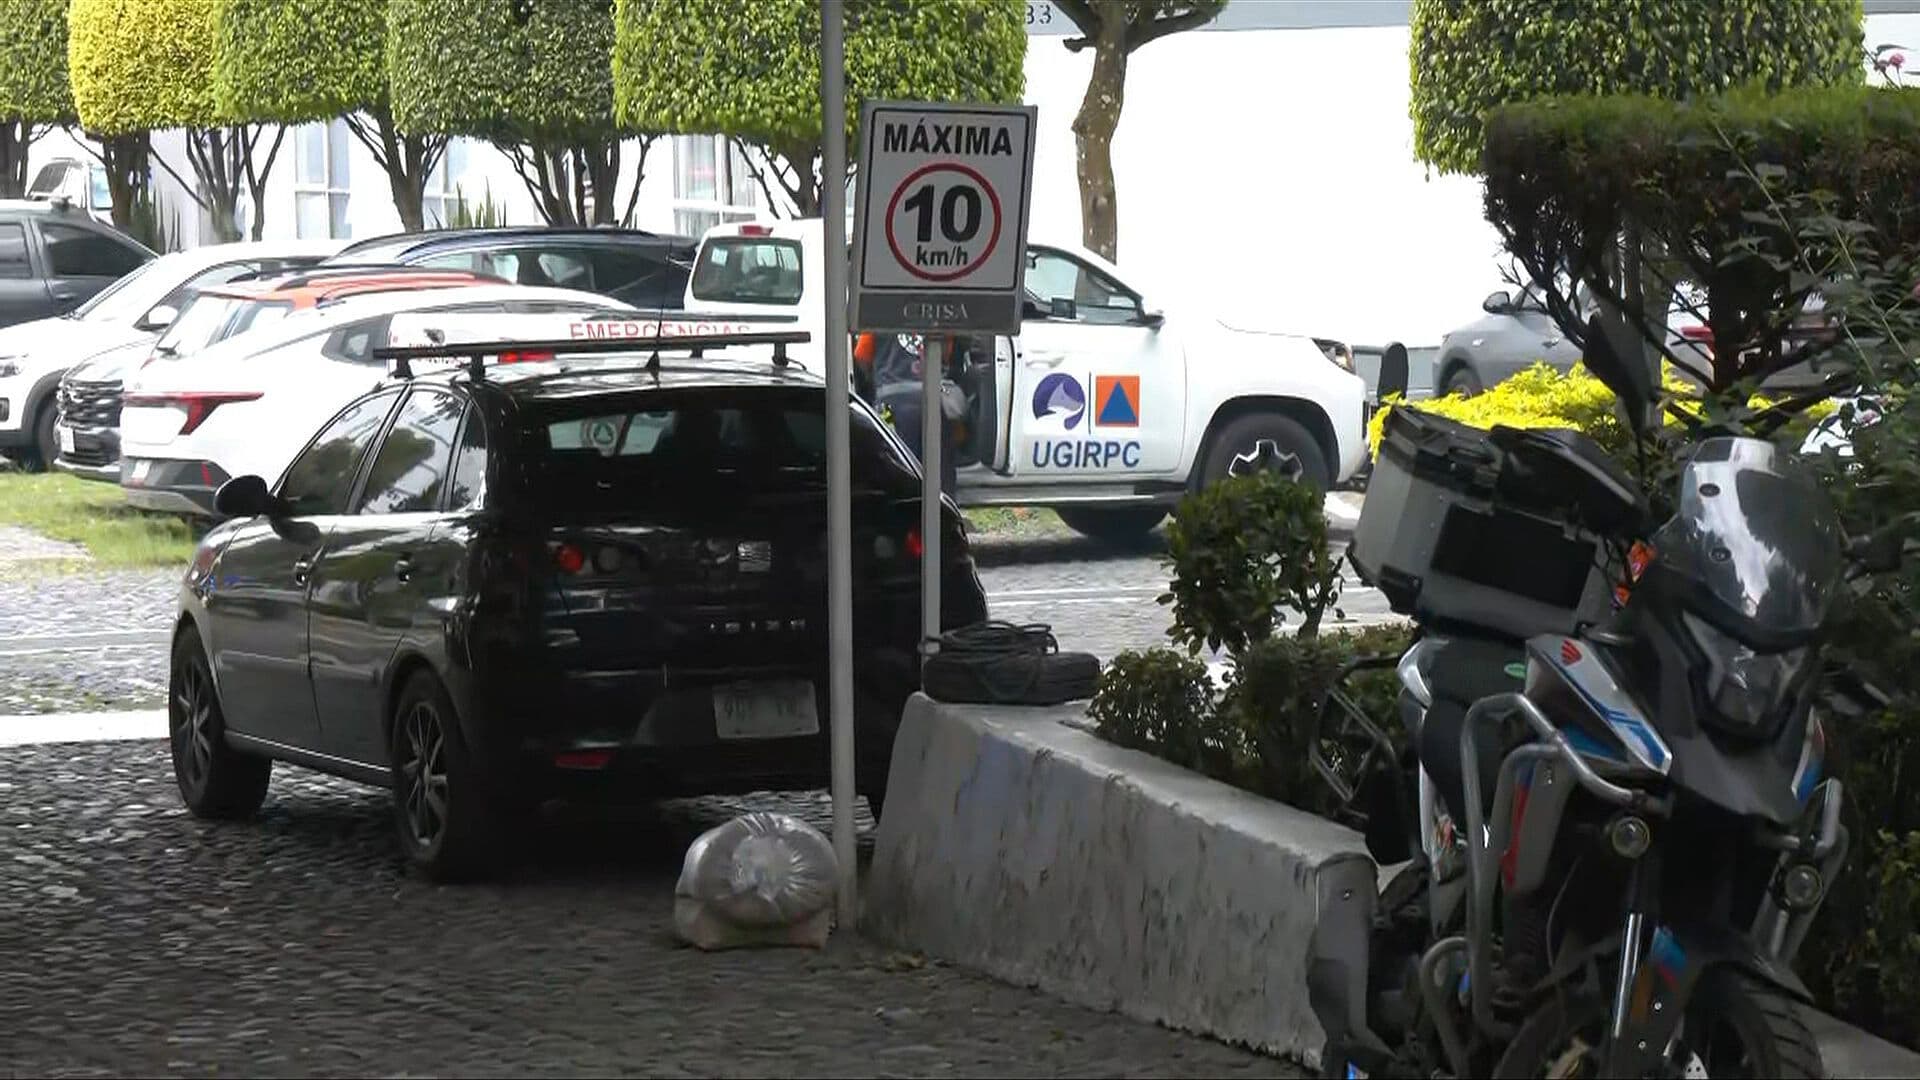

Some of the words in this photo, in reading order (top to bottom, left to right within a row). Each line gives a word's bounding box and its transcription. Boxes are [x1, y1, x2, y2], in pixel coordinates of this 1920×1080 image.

[883, 114, 1012, 156] MÁXIMA
[904, 184, 982, 243] 10
[916, 245, 969, 266] km/h
[902, 303, 969, 319] CRISA
[1033, 441, 1141, 468] UGIRPC
